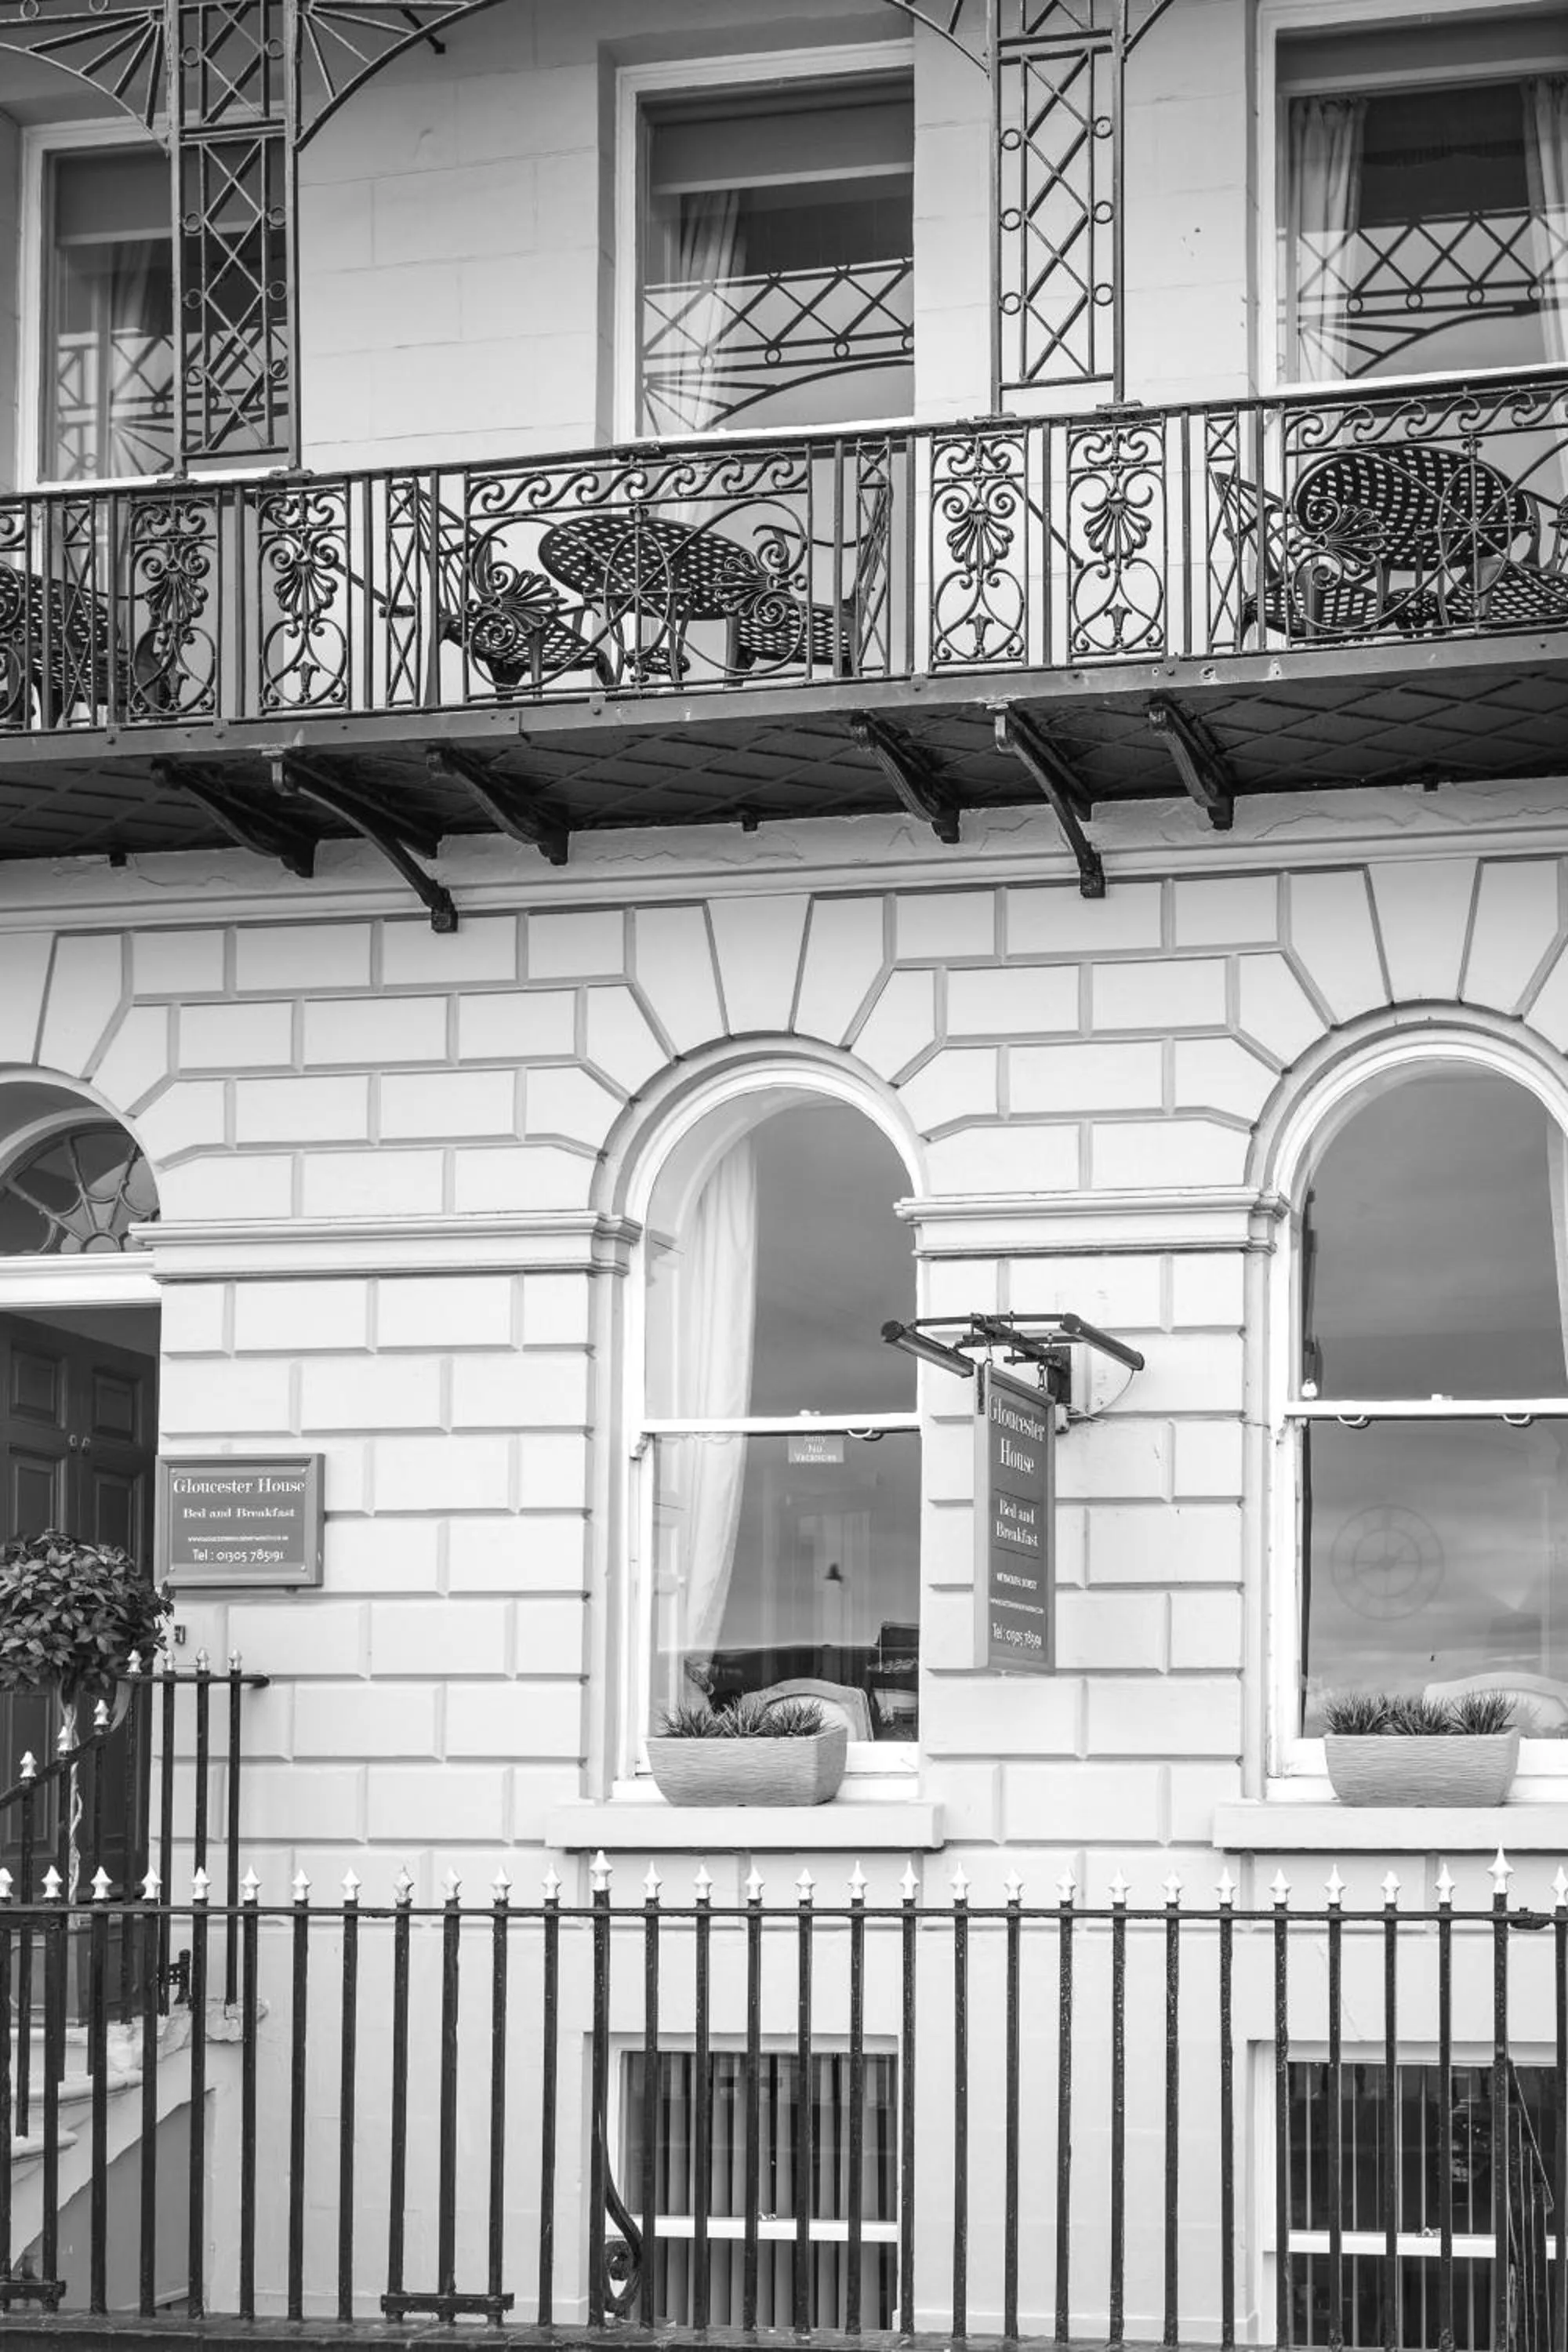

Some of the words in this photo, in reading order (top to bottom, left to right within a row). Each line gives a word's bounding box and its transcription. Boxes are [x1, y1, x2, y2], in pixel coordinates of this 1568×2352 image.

[989, 1395, 1045, 1442] Gloucester
[1000, 1437, 1035, 1473] House
[173, 1478, 253, 1494] Gloucester
[257, 1477, 305, 1494] House
[183, 1508, 206, 1519] Bed
[209, 1508, 231, 1518] and
[237, 1508, 295, 1518] Breakfast
[1000, 1498, 1017, 1519] Bed
[193, 1548, 208, 1561] Tel
[216, 1551, 248, 1563] 01305
